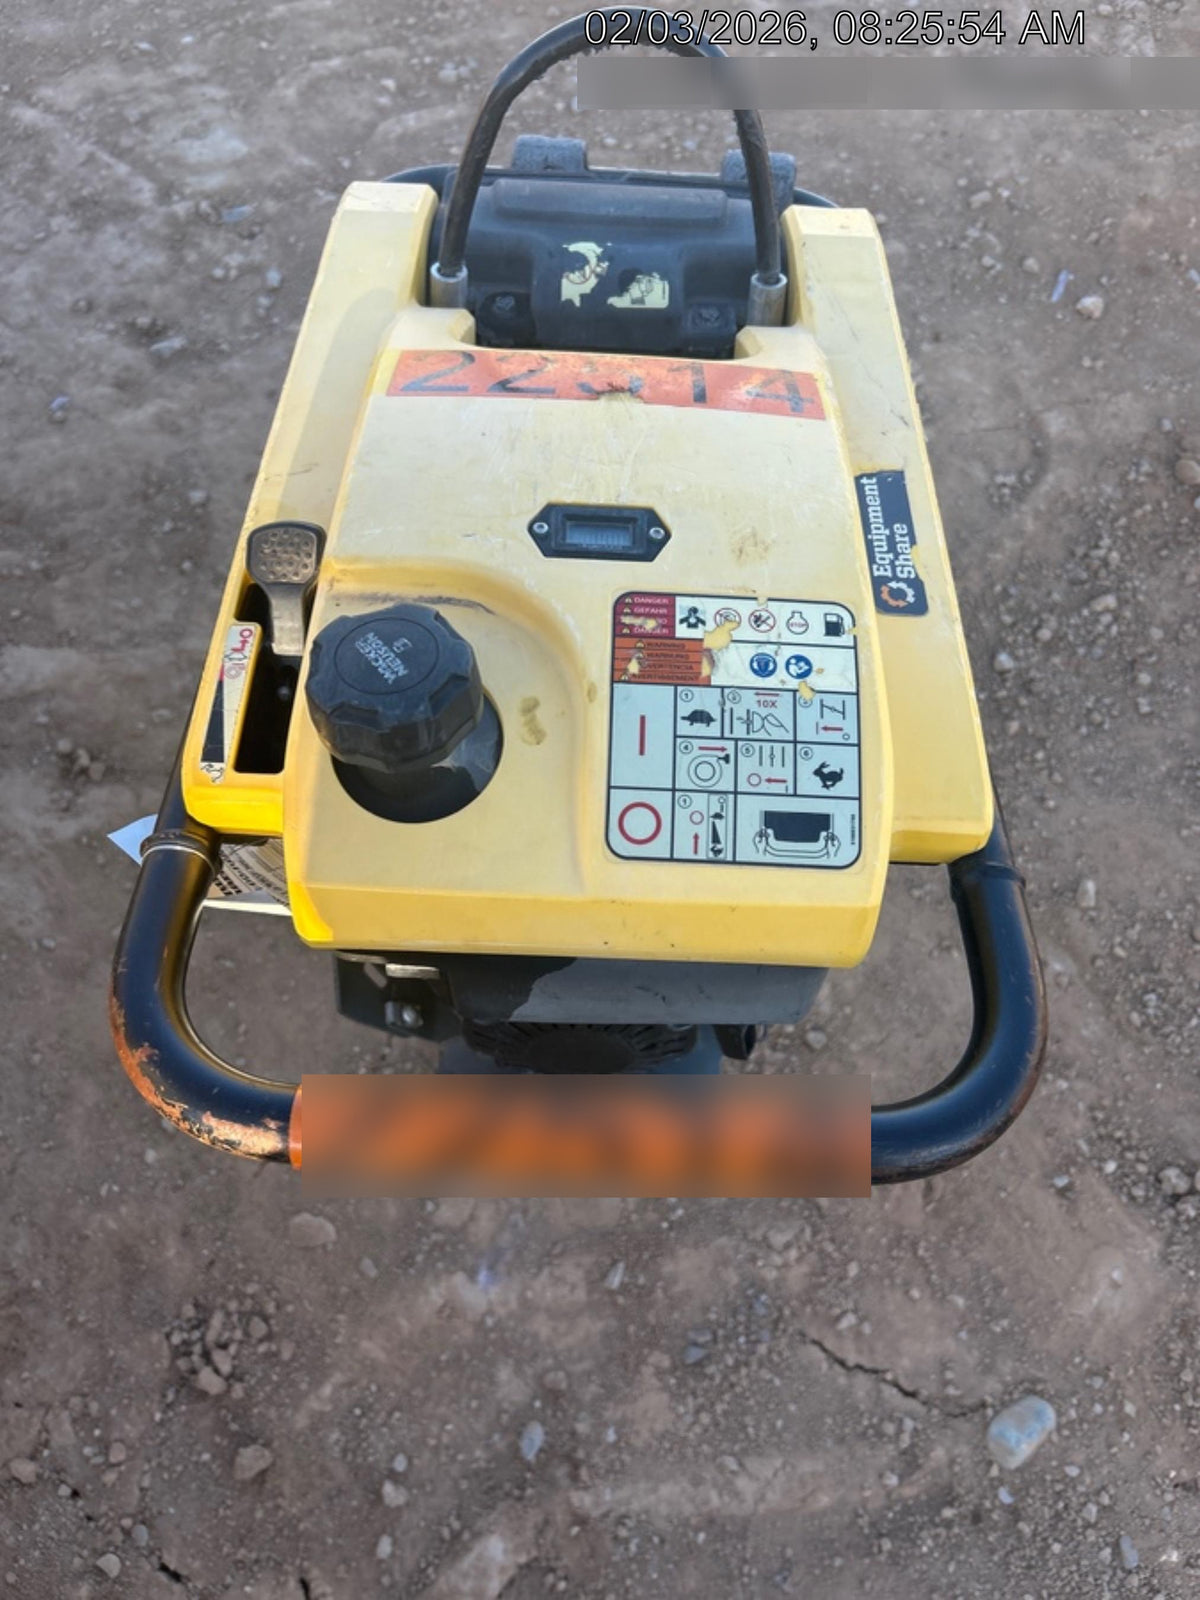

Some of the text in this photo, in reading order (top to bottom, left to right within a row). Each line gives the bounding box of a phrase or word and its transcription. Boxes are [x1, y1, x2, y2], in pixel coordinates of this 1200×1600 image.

[860, 476, 894, 578] Equipment
[893, 523, 916, 579] Share
[756, 699, 778, 708] 10X
